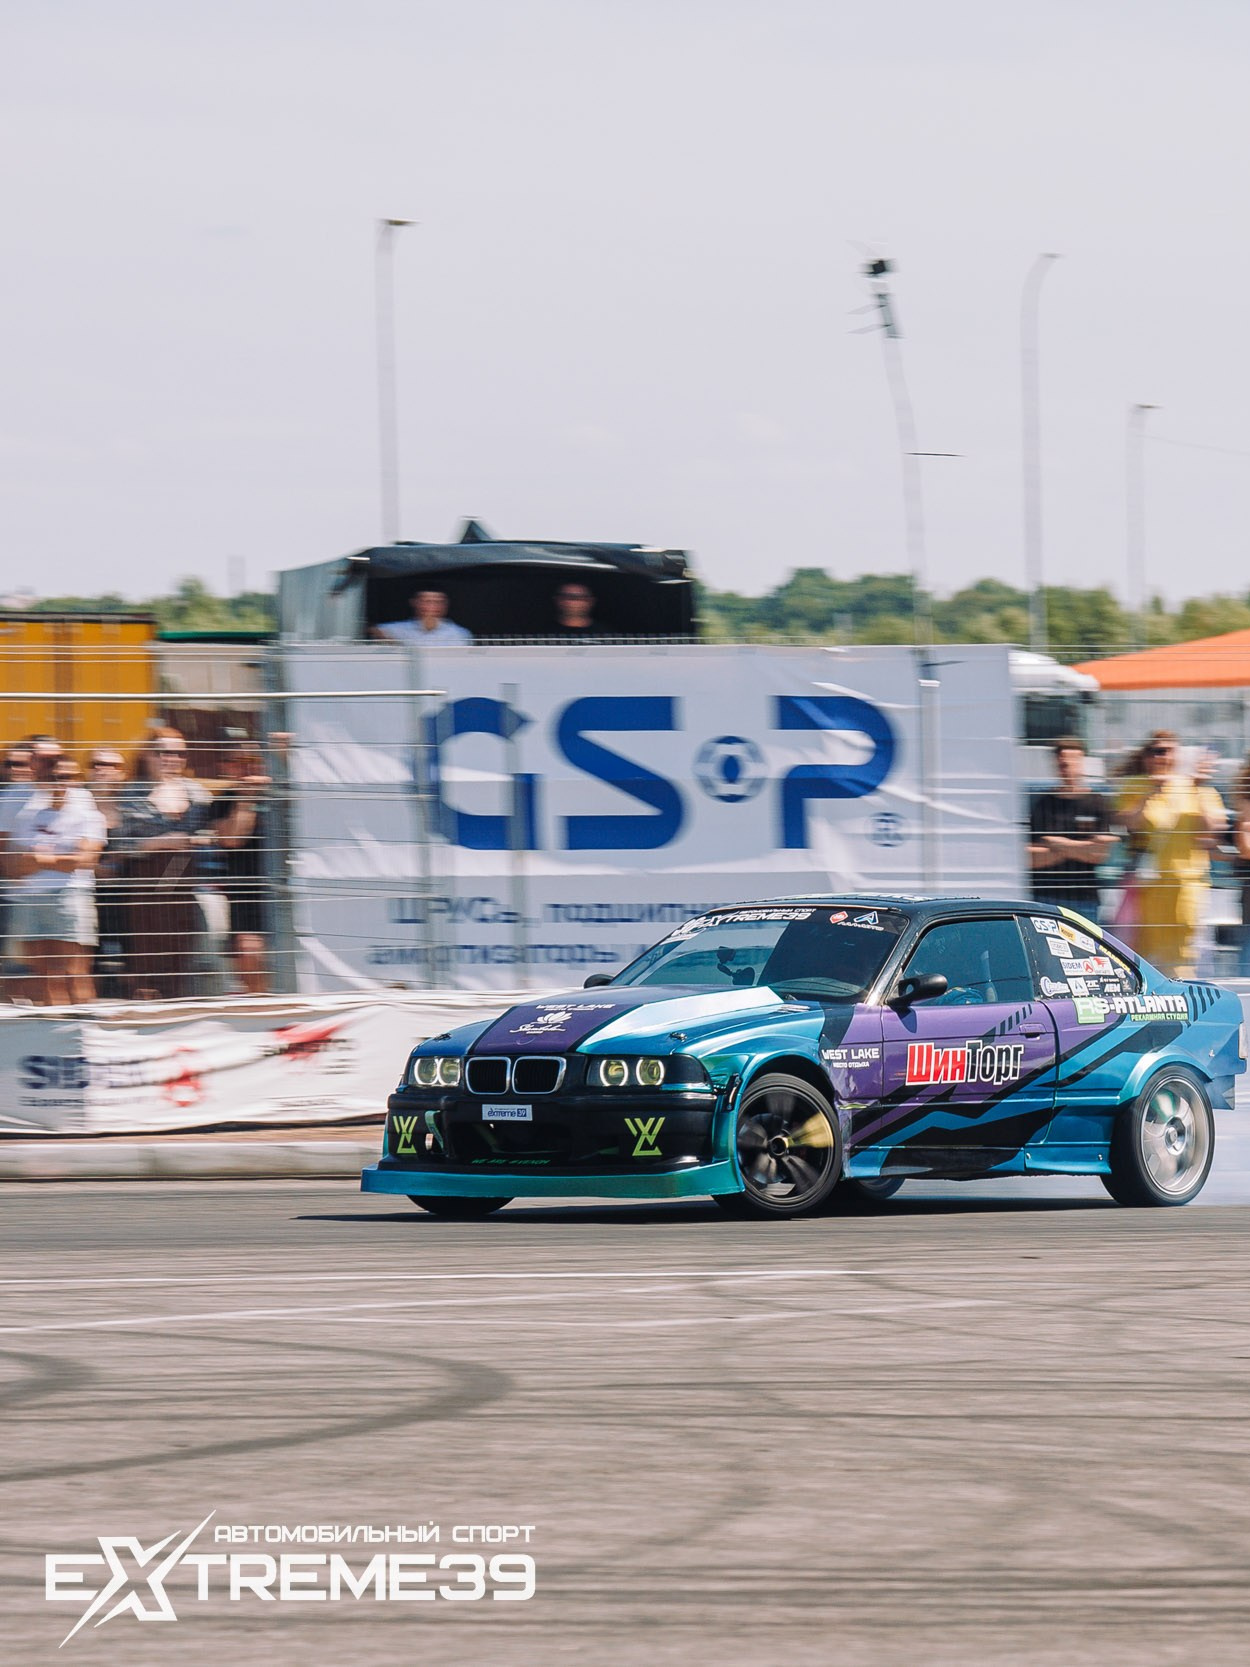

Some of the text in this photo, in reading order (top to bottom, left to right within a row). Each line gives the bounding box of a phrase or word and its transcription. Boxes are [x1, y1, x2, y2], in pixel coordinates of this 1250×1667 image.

[546, 903, 732, 927] подшипн
[1062, 961, 1083, 970] SIDEM
[1079, 995, 1188, 1014] RS-ATLANTA
[821, 1047, 880, 1060] WEST LAKE
[906, 1040, 1024, 1086] ШинТорг
